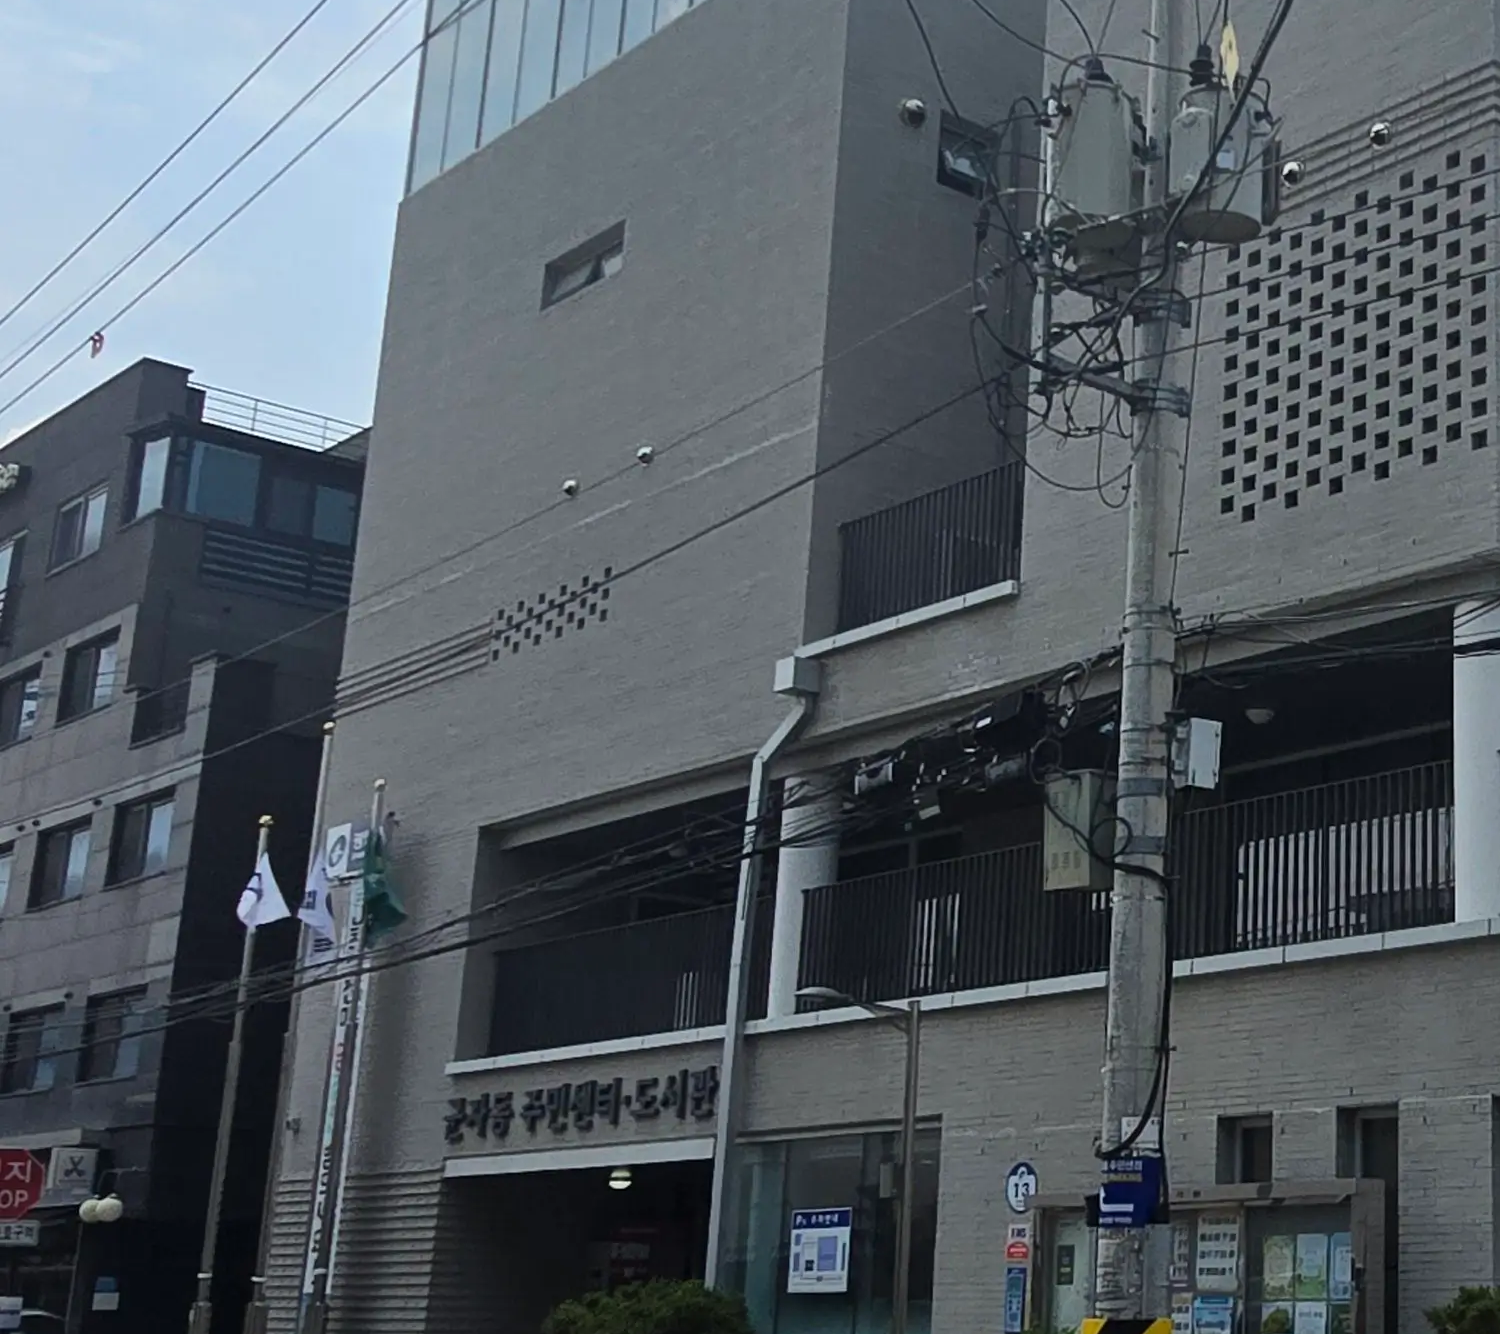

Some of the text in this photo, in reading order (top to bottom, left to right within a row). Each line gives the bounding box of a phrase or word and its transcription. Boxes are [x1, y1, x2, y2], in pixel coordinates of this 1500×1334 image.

[443, 1092, 515, 1145] 군자동
[0, 1157, 32, 1184] 지
[0, 1188, 29, 1209] OP
[1013, 1182, 1031, 1200] 13
